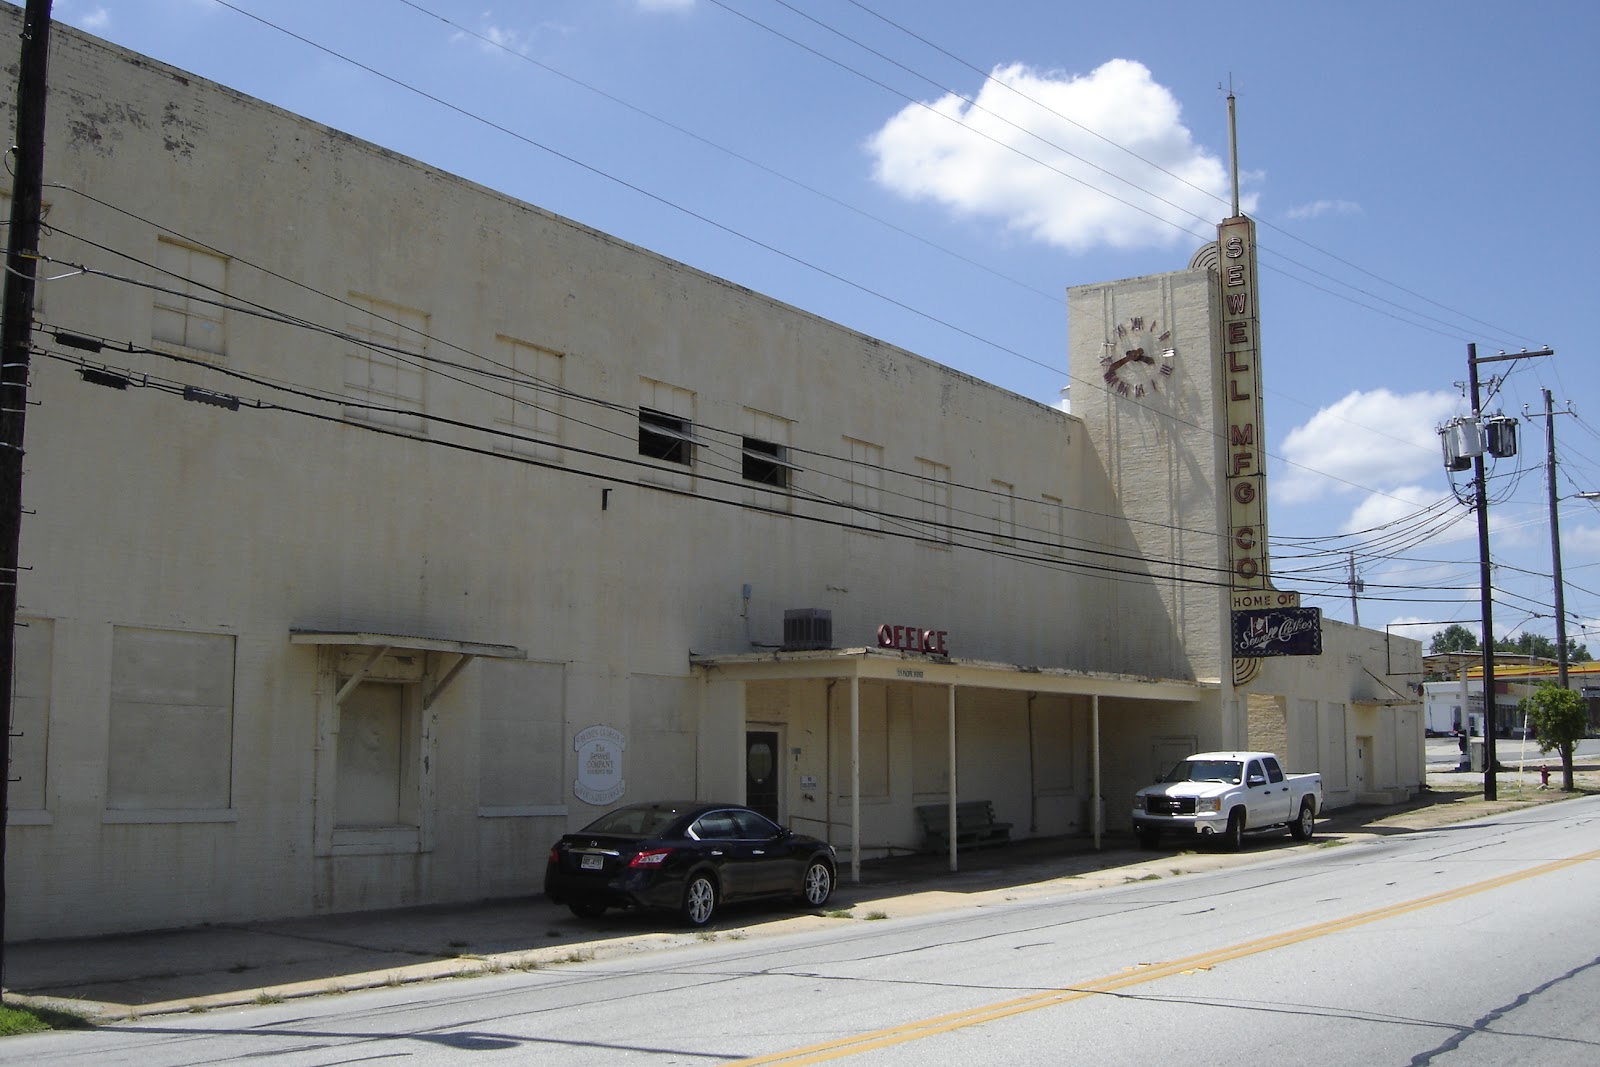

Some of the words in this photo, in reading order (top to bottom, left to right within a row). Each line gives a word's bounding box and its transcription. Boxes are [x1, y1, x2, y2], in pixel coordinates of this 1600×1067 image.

[1226, 237, 1249, 401] SEWELL
[1231, 424, 1255, 504] MFG
[1236, 527, 1257, 579] CO
[1234, 595, 1270, 608] HOME
[1277, 594, 1296, 605] OF
[878, 624, 948, 654] OFFICE
